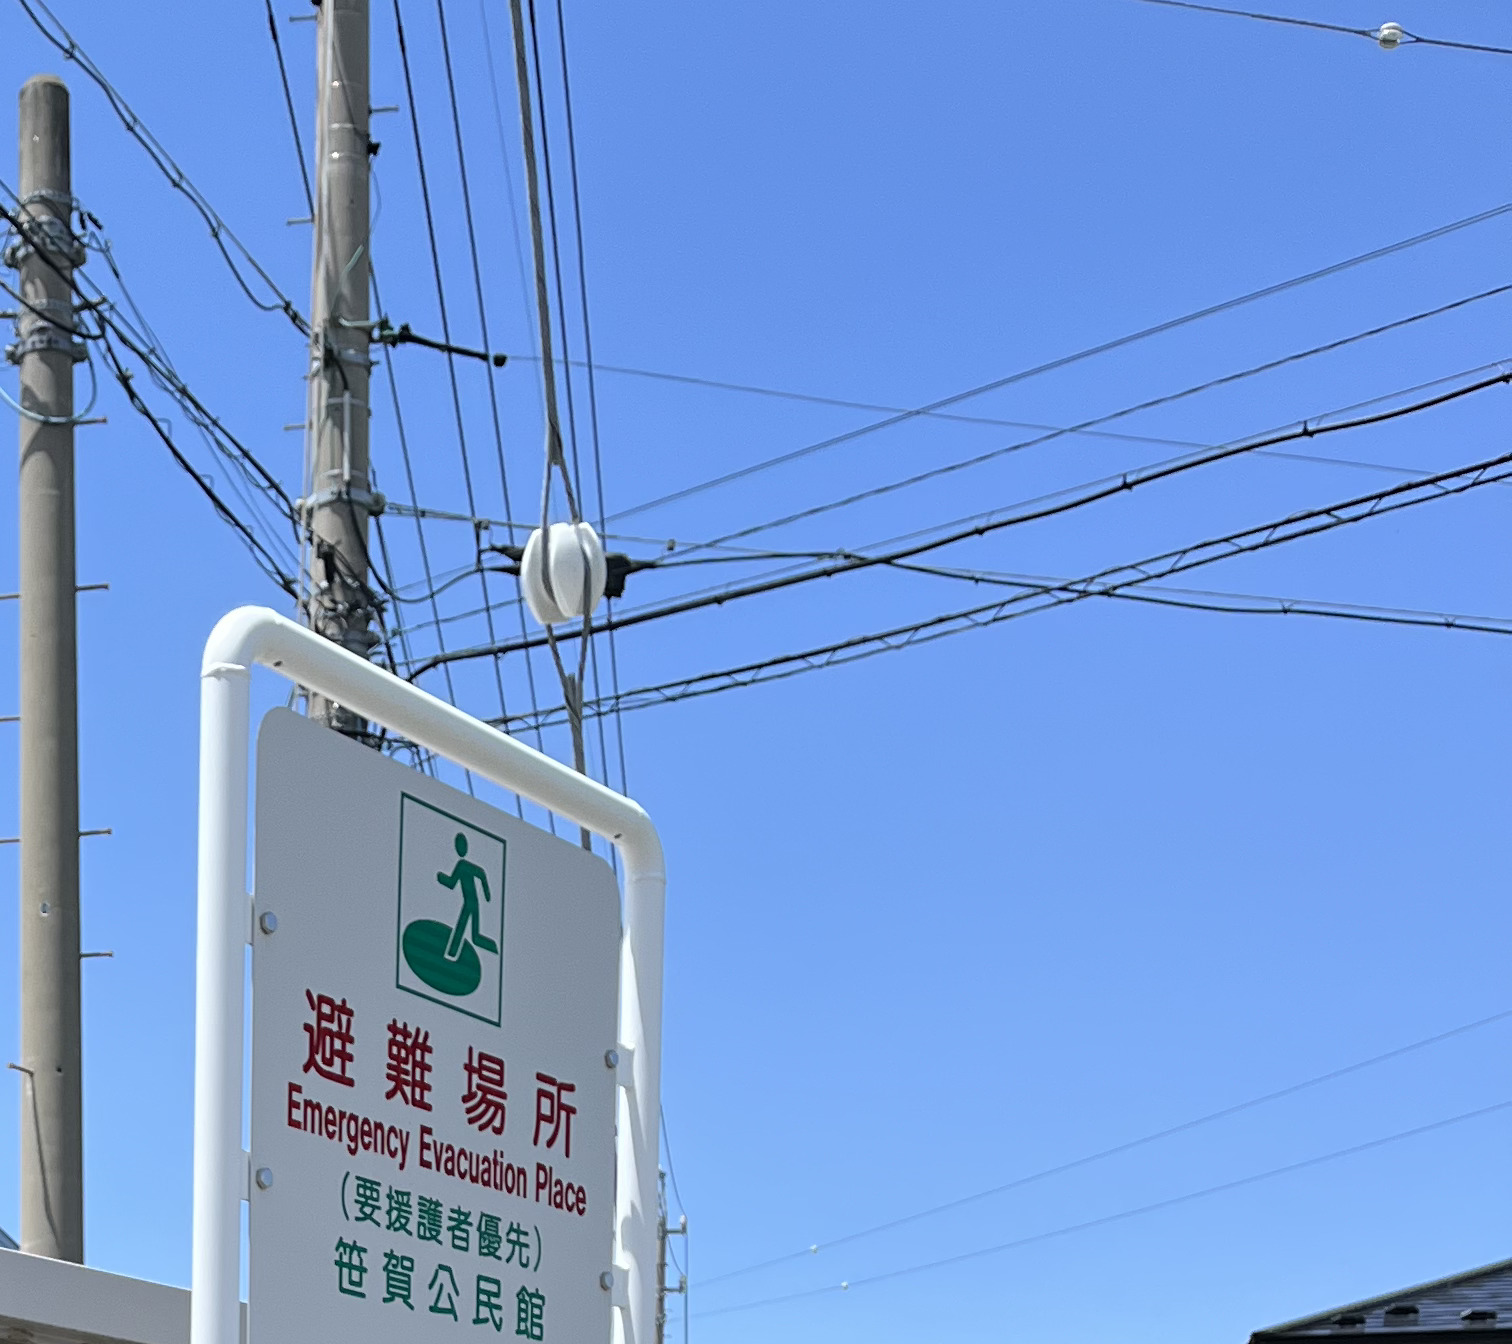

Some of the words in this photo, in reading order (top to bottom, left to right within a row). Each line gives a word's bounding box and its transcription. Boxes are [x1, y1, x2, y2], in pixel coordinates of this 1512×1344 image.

[303, 988, 577, 1159] 避難場所
[287, 1081, 410, 1171] Emergency
[419, 1124, 527, 1199] Evacuation
[535, 1162, 587, 1217] Place
[341, 1171, 543, 1273] （要援護者優先）
[334, 1236, 546, 1341] 笹賀公民館
